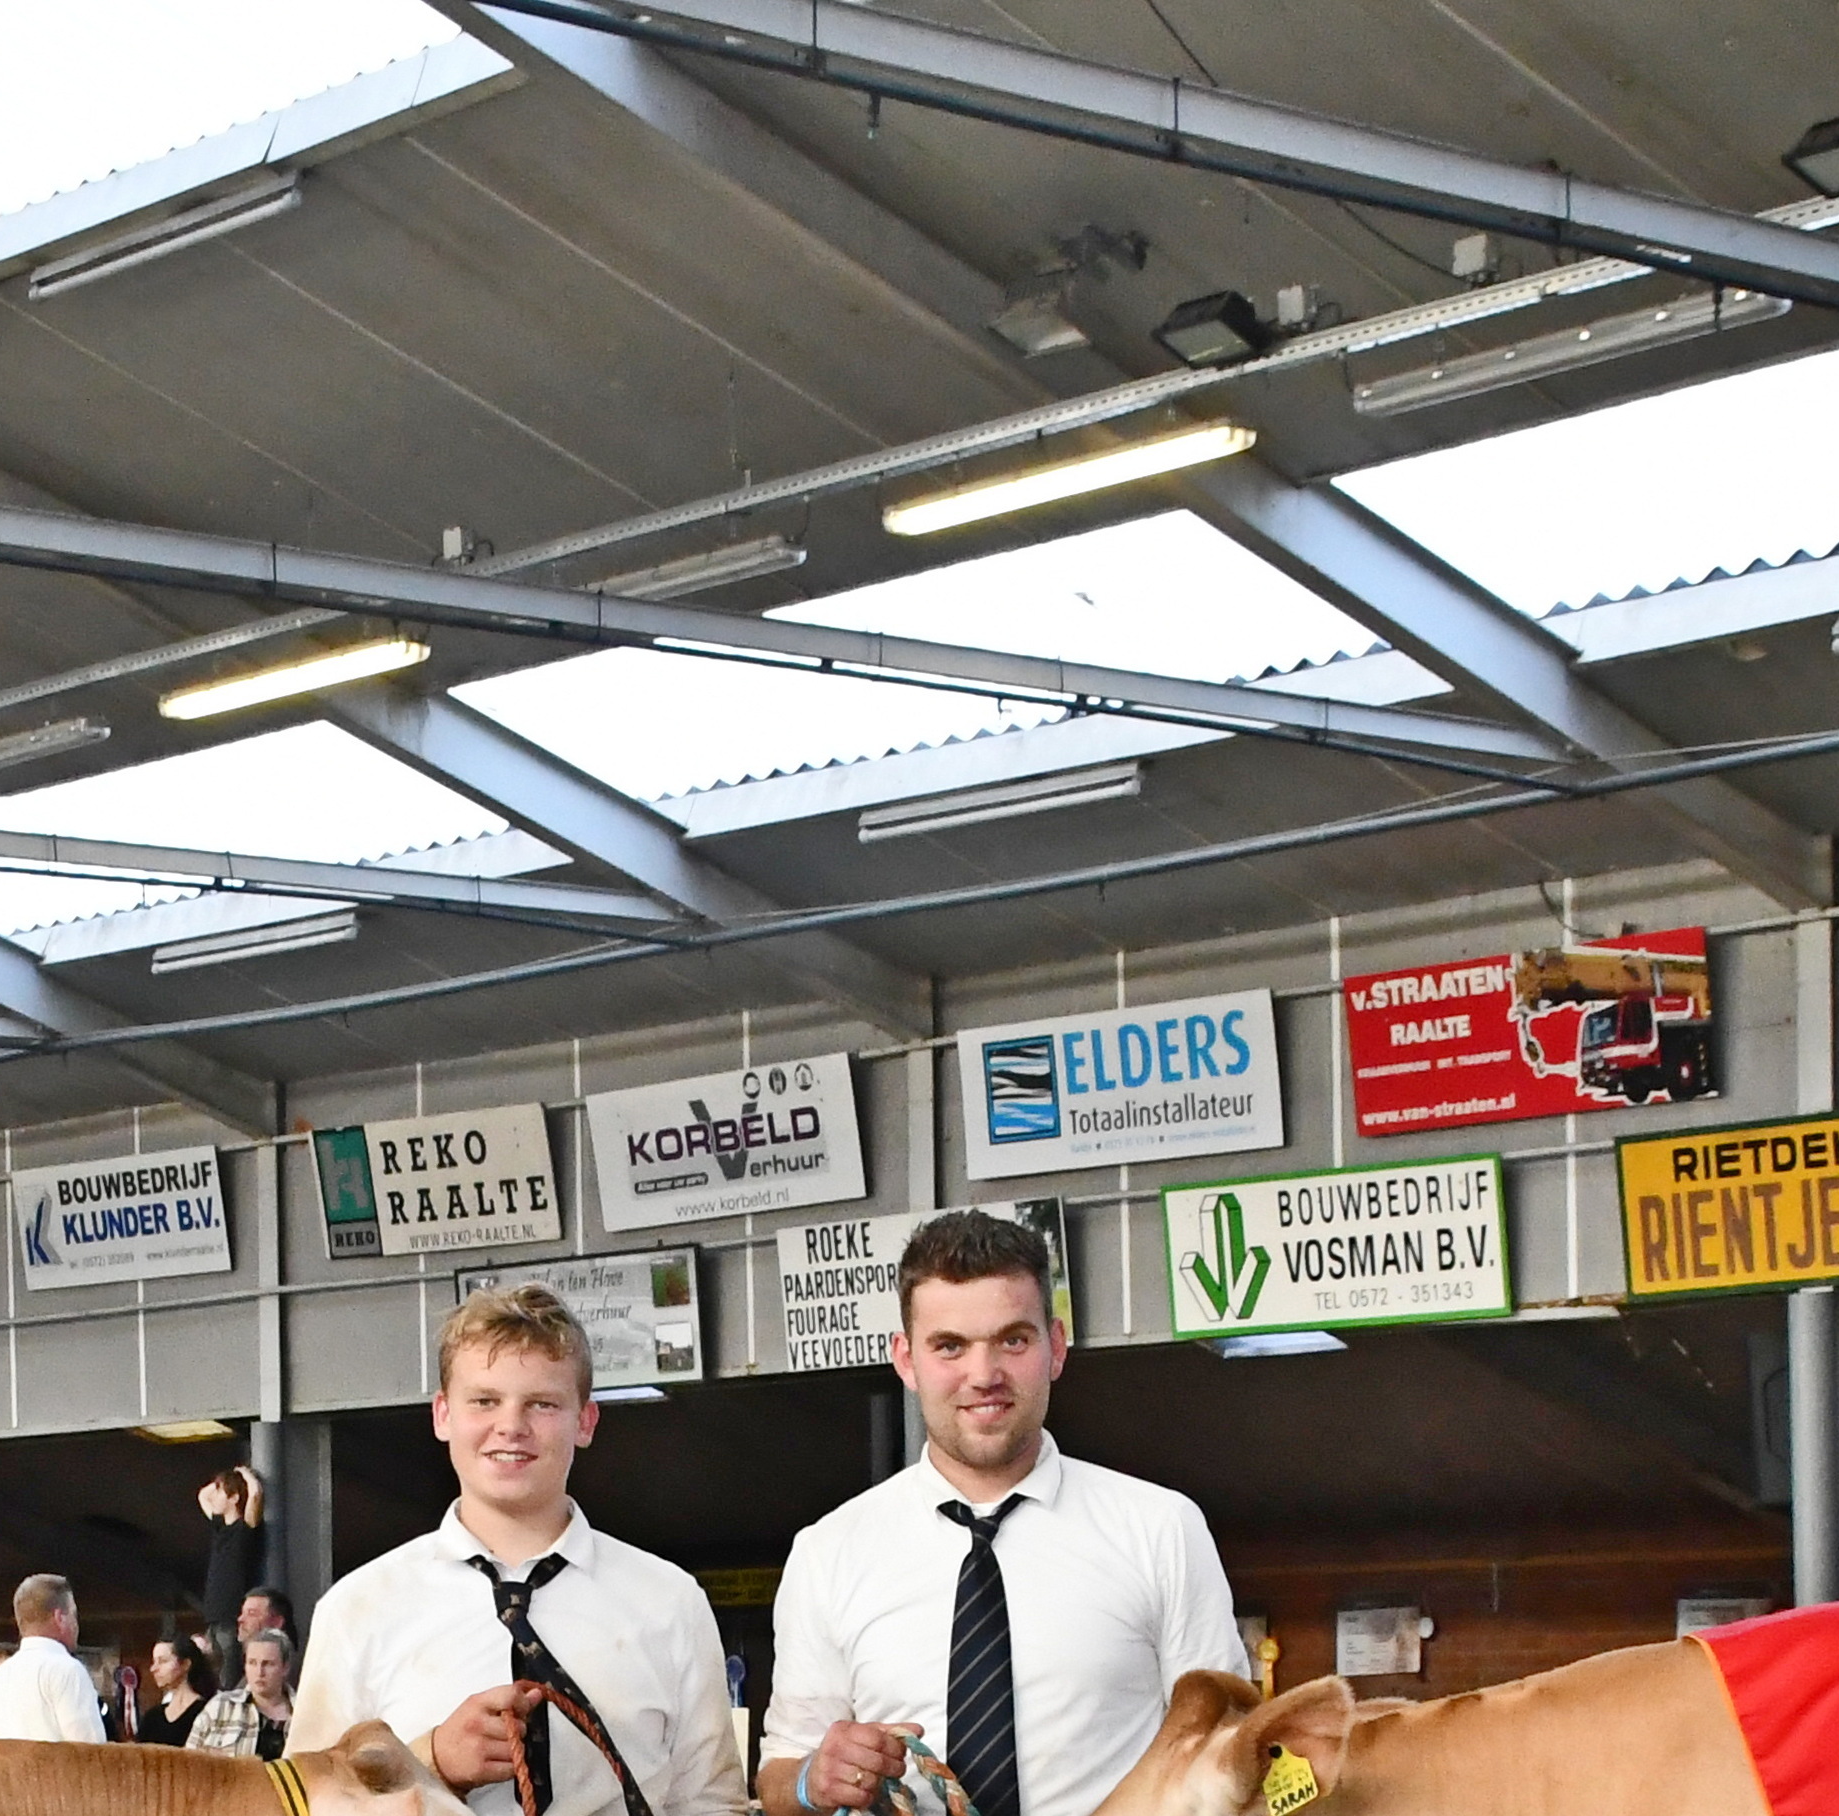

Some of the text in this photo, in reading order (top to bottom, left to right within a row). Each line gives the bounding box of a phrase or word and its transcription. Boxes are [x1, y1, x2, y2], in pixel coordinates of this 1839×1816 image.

[1350, 964, 1506, 1012] v.STRAATEN
[1062, 1009, 1251, 1095] ELDERS
[1390, 1014, 1472, 1046] RAALTE
[1069, 1092, 1254, 1135] Totaalinstallateur
[379, 1130, 487, 1175] REKO
[627, 1106, 821, 1166] KORBELD
[57, 1160, 212, 1206] BOUWBEDRIJF
[387, 1176, 549, 1225] RAALTE
[675, 1188, 790, 1218] www.korbeld.nl
[1277, 1170, 1489, 1228] BOUWBEDRIJF
[62, 1197, 221, 1245] KLUNDER B.V.
[335, 1231, 375, 1248] REKO
[805, 1221, 874, 1265] ROEKE
[1283, 1224, 1495, 1283] VOSMAN B.V.
[783, 1262, 899, 1303] PAARDENSPOR
[1314, 1291, 1341, 1310] TEL
[1348, 1287, 1389, 1308] 0572
[1411, 1280, 1474, 1304] 351343
[787, 1302, 860, 1337] FOURAGE
[788, 1331, 894, 1370] VEEVOEDER
[1271, 1782, 1315, 1816] SARAH
